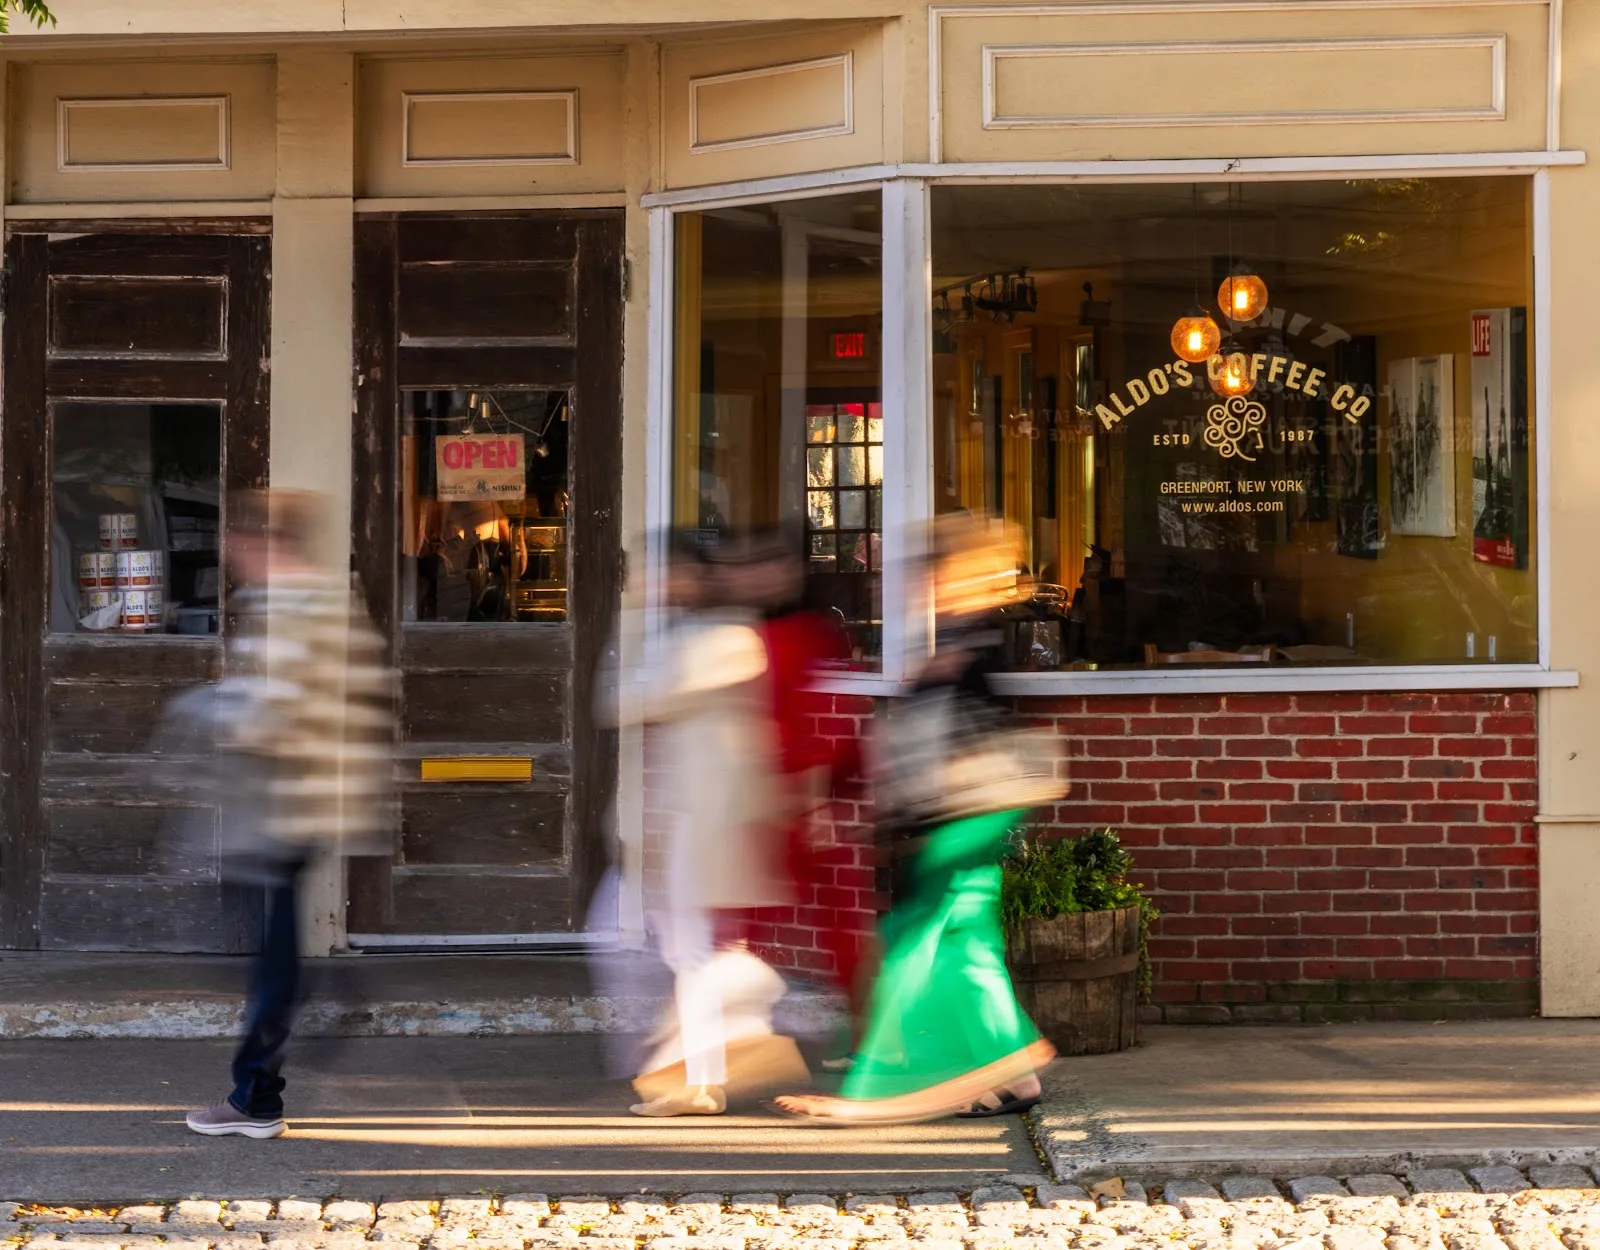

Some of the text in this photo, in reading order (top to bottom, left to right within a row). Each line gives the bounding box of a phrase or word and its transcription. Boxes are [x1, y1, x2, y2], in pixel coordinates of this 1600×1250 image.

[835, 333, 864, 357] EXIT
[1472, 319, 1490, 352] LIFE
[1094, 360, 1194, 431] ALDO'S
[1207, 352, 1327, 398] COFFEE
[1153, 433, 1190, 446] ESTD
[1280, 430, 1315, 442] 1987
[443, 440, 517, 469] OPEN
[1160, 480, 1304, 496] GREENPORT, NEW YORK
[1181, 500, 1284, 513] www.aldos.com
